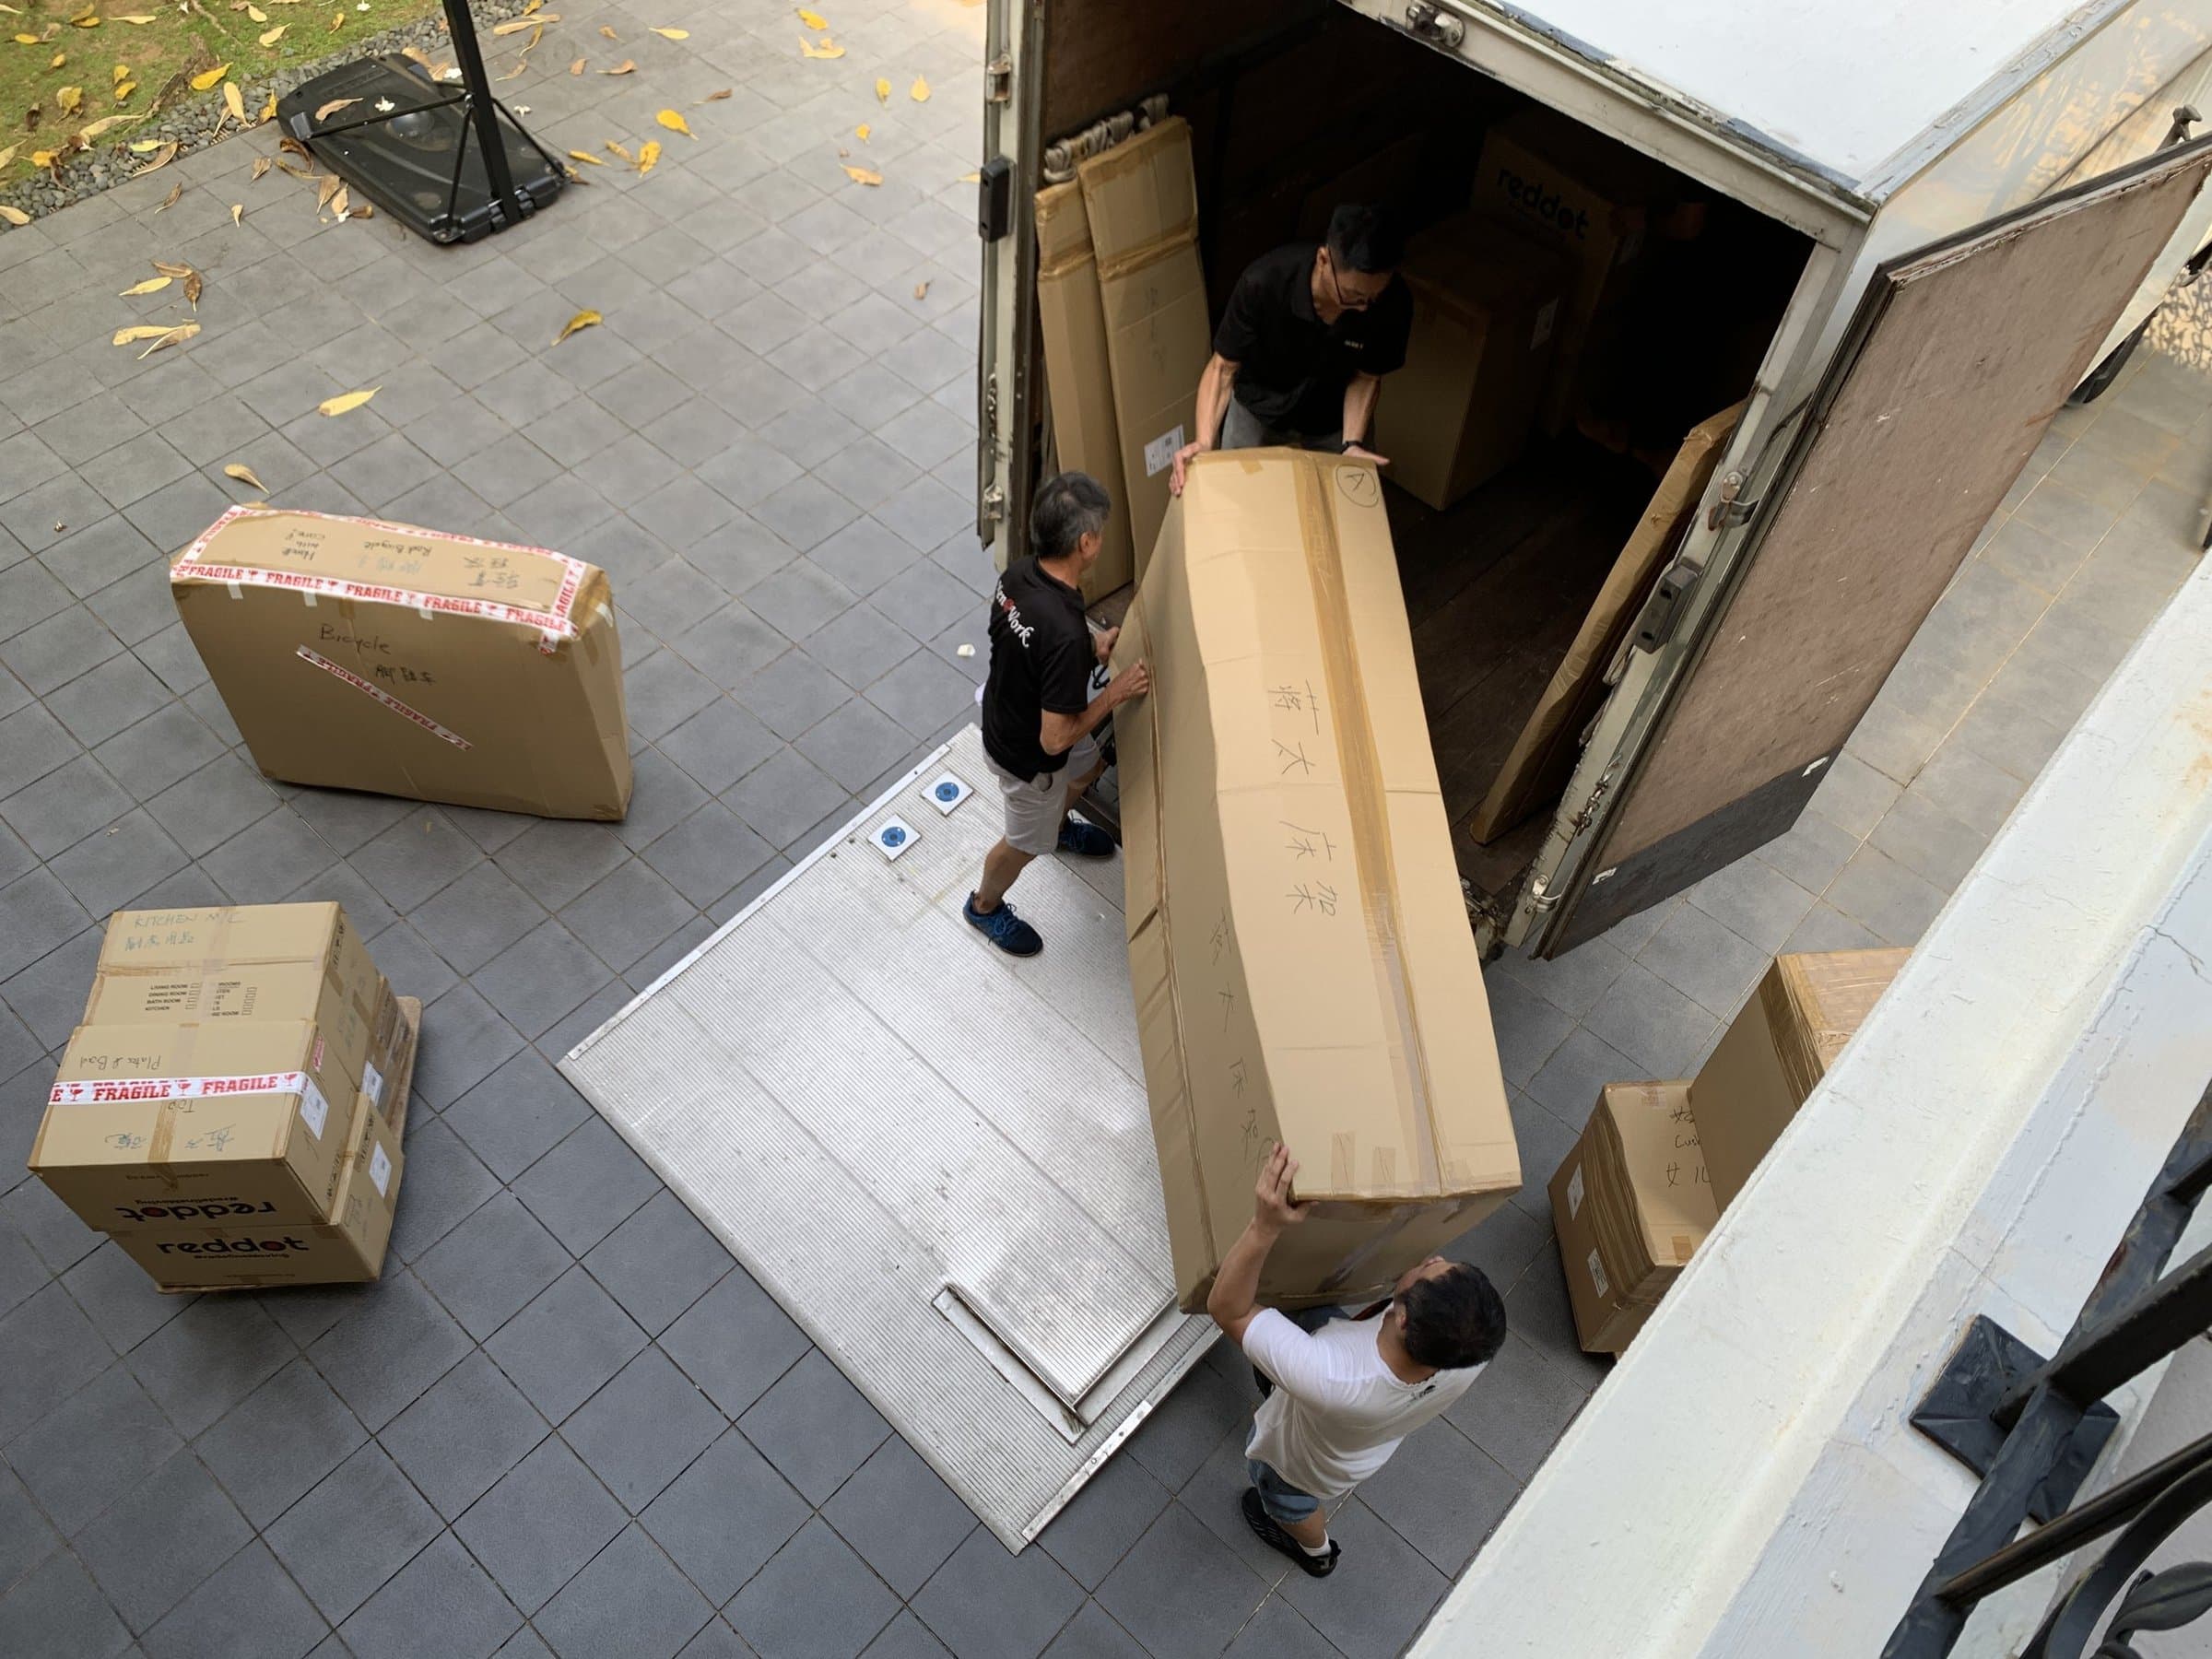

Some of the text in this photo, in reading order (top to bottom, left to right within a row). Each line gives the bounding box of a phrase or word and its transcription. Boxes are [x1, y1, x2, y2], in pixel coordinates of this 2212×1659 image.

[1497, 169, 1589, 240] reddot
[188, 566, 566, 633] FRAGILE FRAGILE FRAGILE FRAGILE FRAGILE
[320, 624, 391, 655] Bicycle
[92, 1085, 171, 1102] FRAGILE
[201, 1076, 278, 1096] FRAGILE
[115, 1201, 276, 1222] reddot
[157, 1237, 310, 1254] reddot
